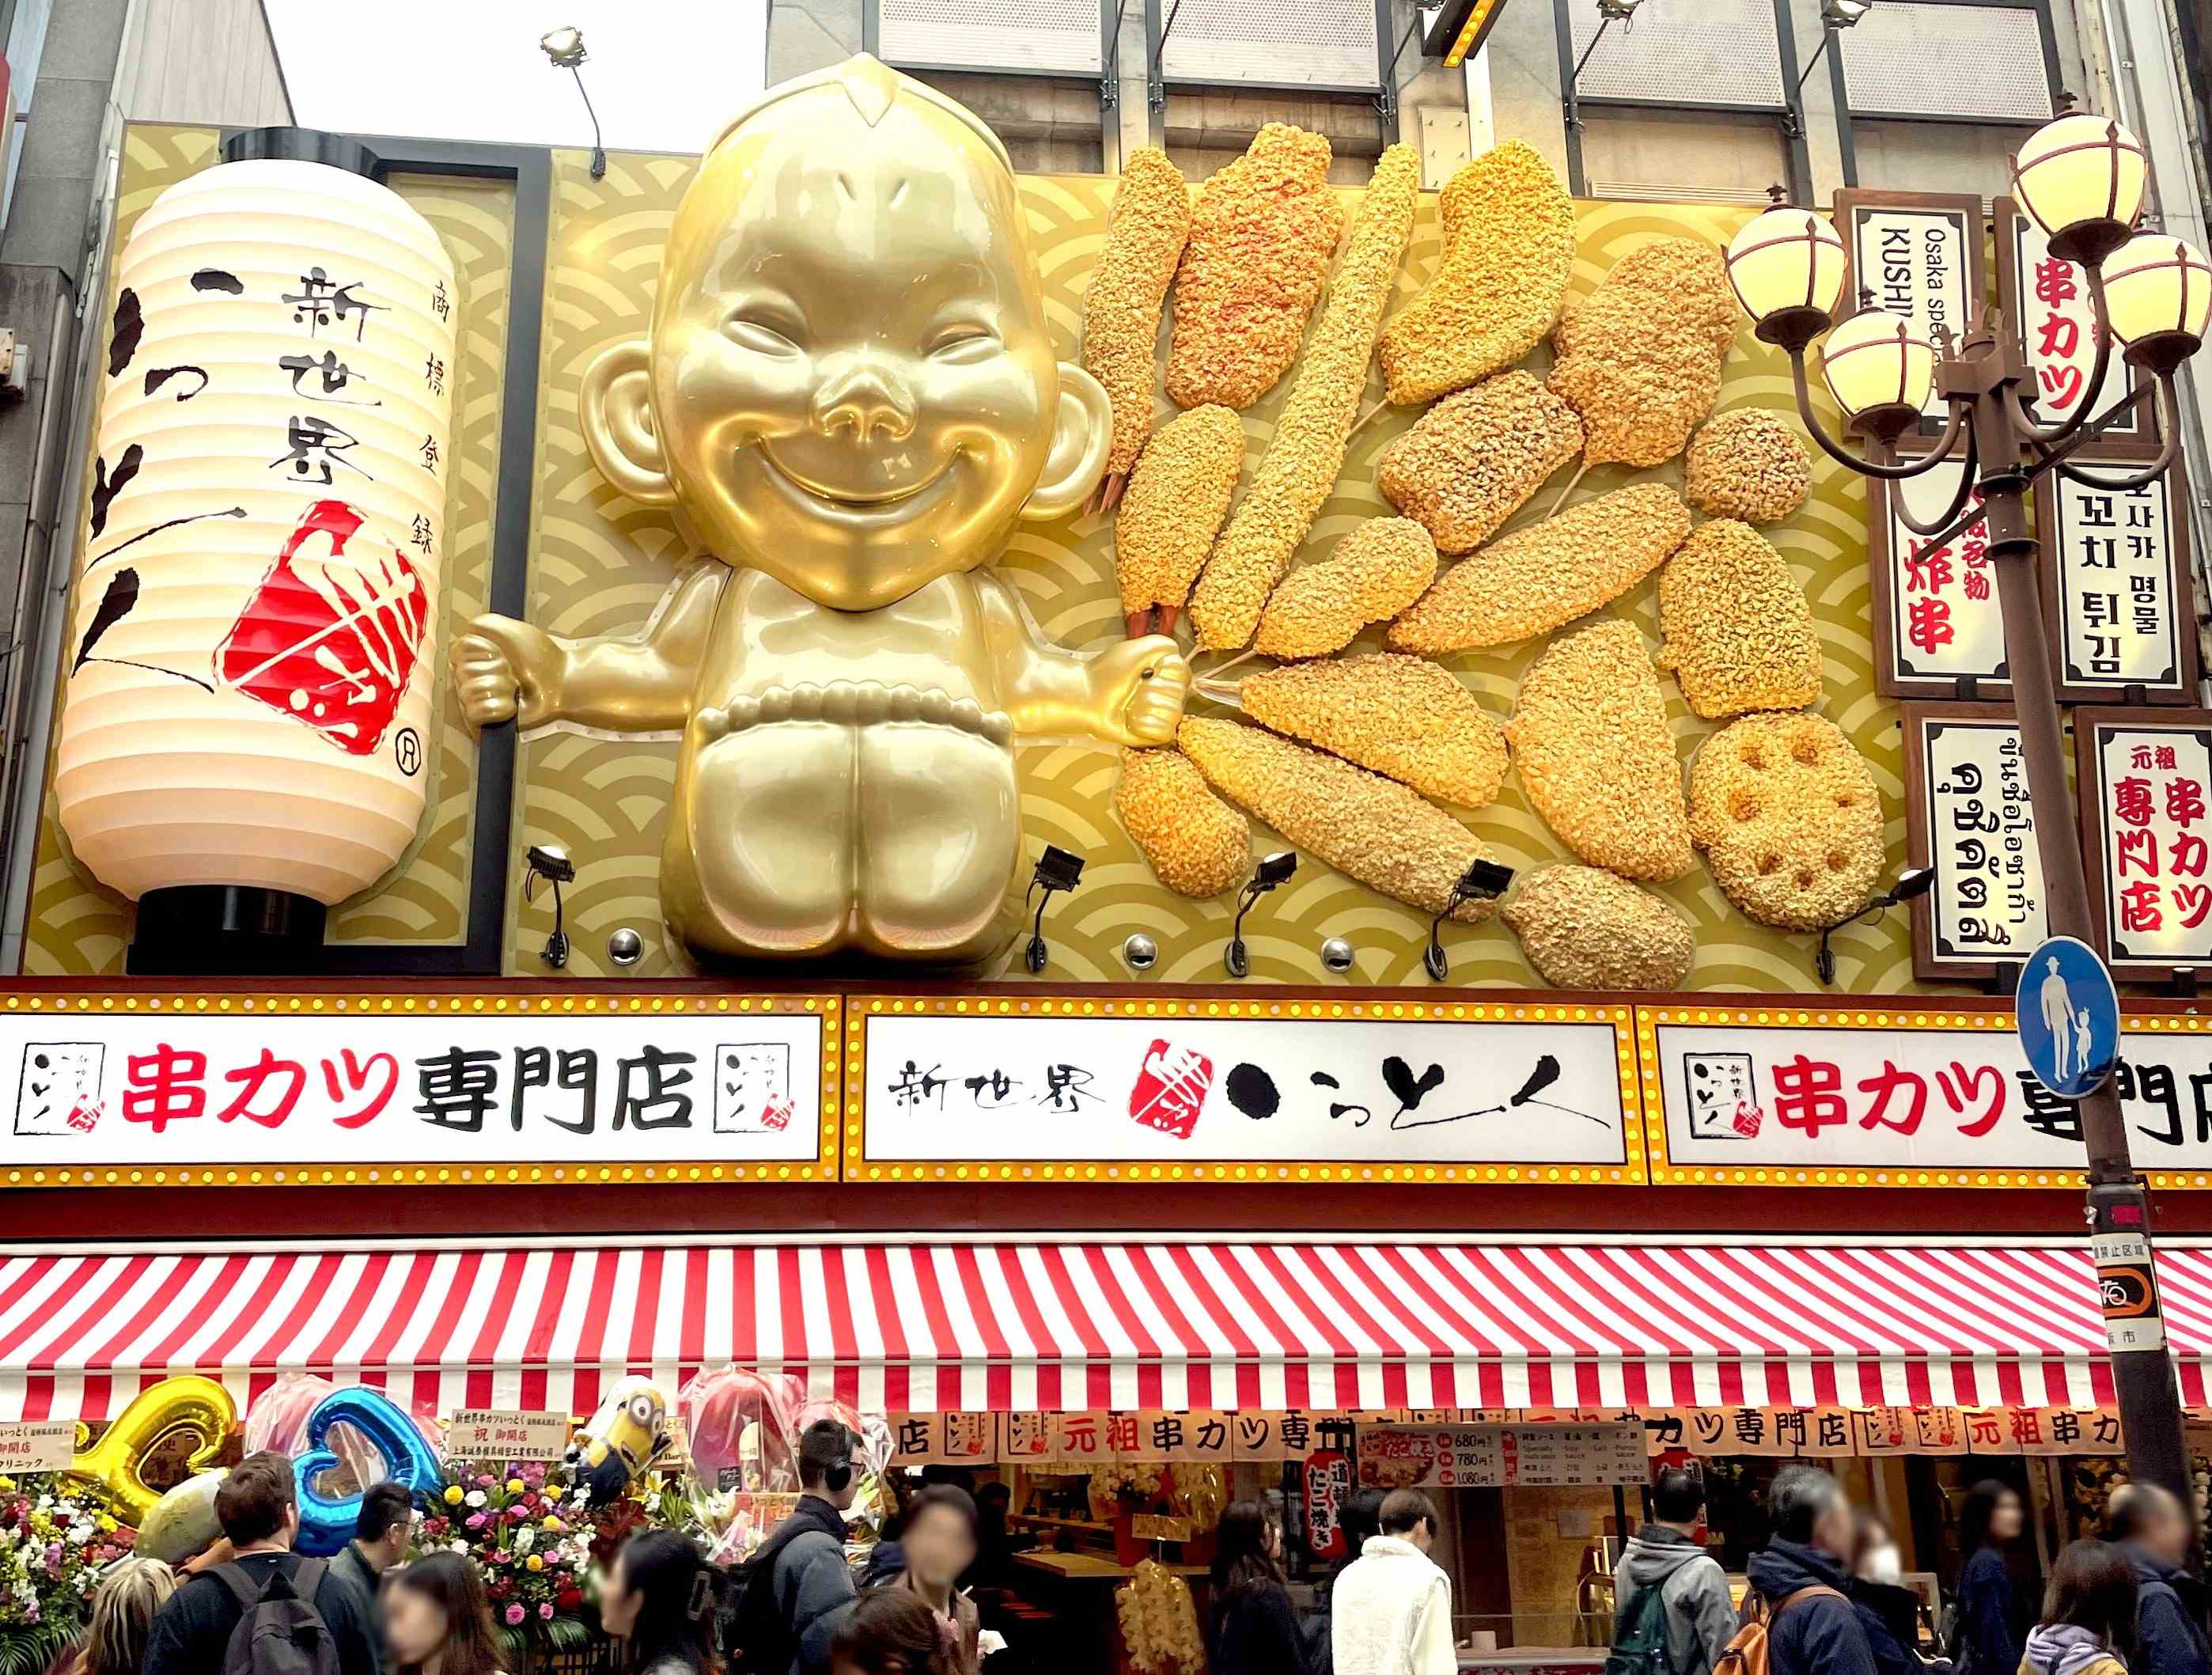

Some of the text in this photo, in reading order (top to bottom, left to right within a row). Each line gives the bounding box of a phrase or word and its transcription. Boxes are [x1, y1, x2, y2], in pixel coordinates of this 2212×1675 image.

[1925, 229, 1949, 290] Osaka
[268, 267, 392, 486] 新世界
[2035, 258, 2083, 411] 串カツ
[410, 279, 451, 556] 商標登録
[2076, 495, 2121, 674] 꼬치 튀김
[2130, 575, 2161, 635] 명물
[2131, 745, 2178, 771] 元祖
[2165, 777, 2212, 929] 串カツ
[121, 1042, 696, 1135] 串カツ専門店
[888, 1059, 1107, 1114] 新世界
[1771, 1055, 2212, 1146] 串カツ専門
[474, 1427, 488, 1442] 祝
[898, 1419, 930, 1454] 店
[1309, 1467, 1330, 1548] たこ焼き
